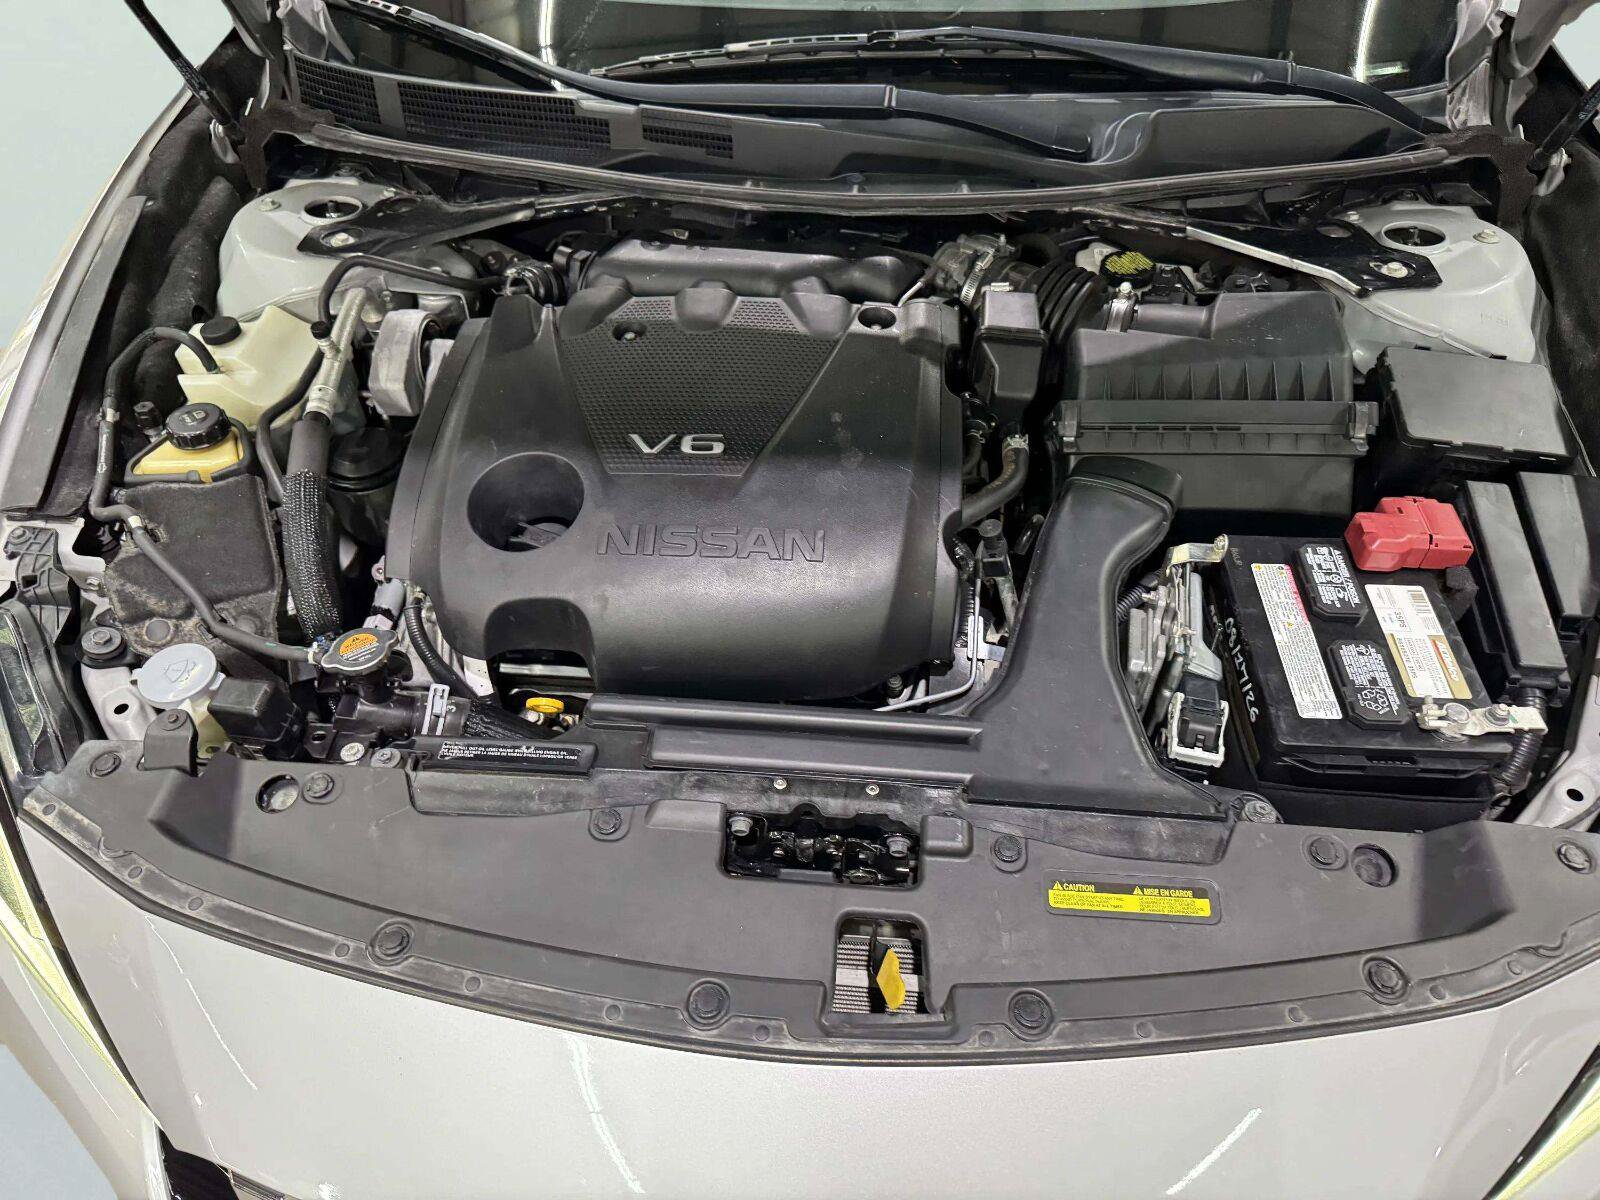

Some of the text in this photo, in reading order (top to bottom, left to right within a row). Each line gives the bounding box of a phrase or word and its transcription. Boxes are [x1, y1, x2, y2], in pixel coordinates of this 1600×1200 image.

[628, 432, 725, 455] V6
[597, 523, 825, 563] NISSAN
[1063, 882, 1095, 892] CAUTION
[1143, 887, 1193, 898] MISE EN GARDE
